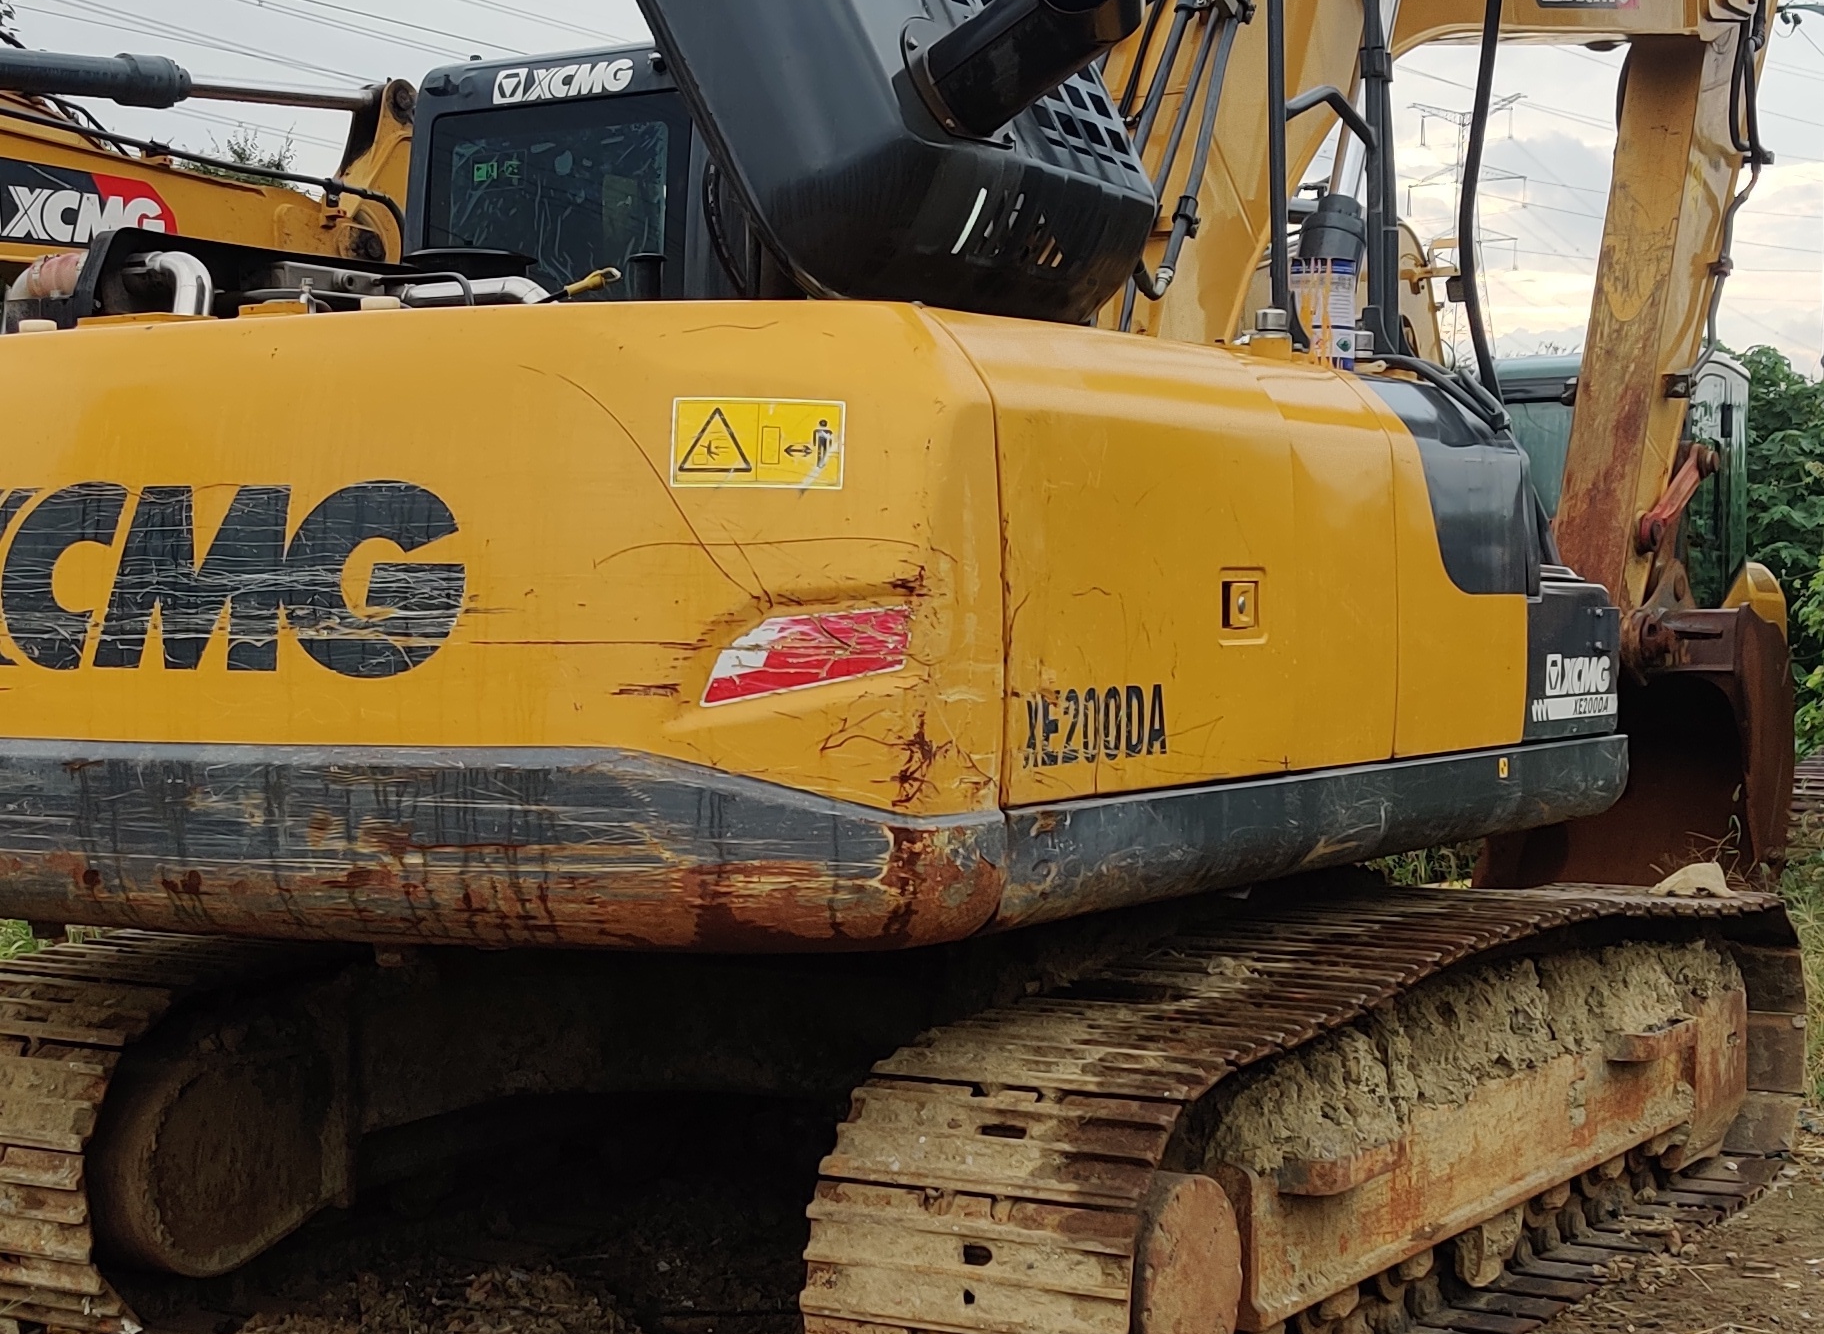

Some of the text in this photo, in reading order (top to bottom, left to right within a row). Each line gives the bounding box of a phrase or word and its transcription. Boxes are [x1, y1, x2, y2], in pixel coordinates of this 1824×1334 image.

[522, 59, 634, 101] XCMG
[1, 185, 166, 243] XCMG
[0, 479, 467, 679] CMG
[1560, 656, 1611, 695] XCMG
[1023, 683, 1168, 768] XE200DA
[1572, 696, 1609, 716] XE200DA
